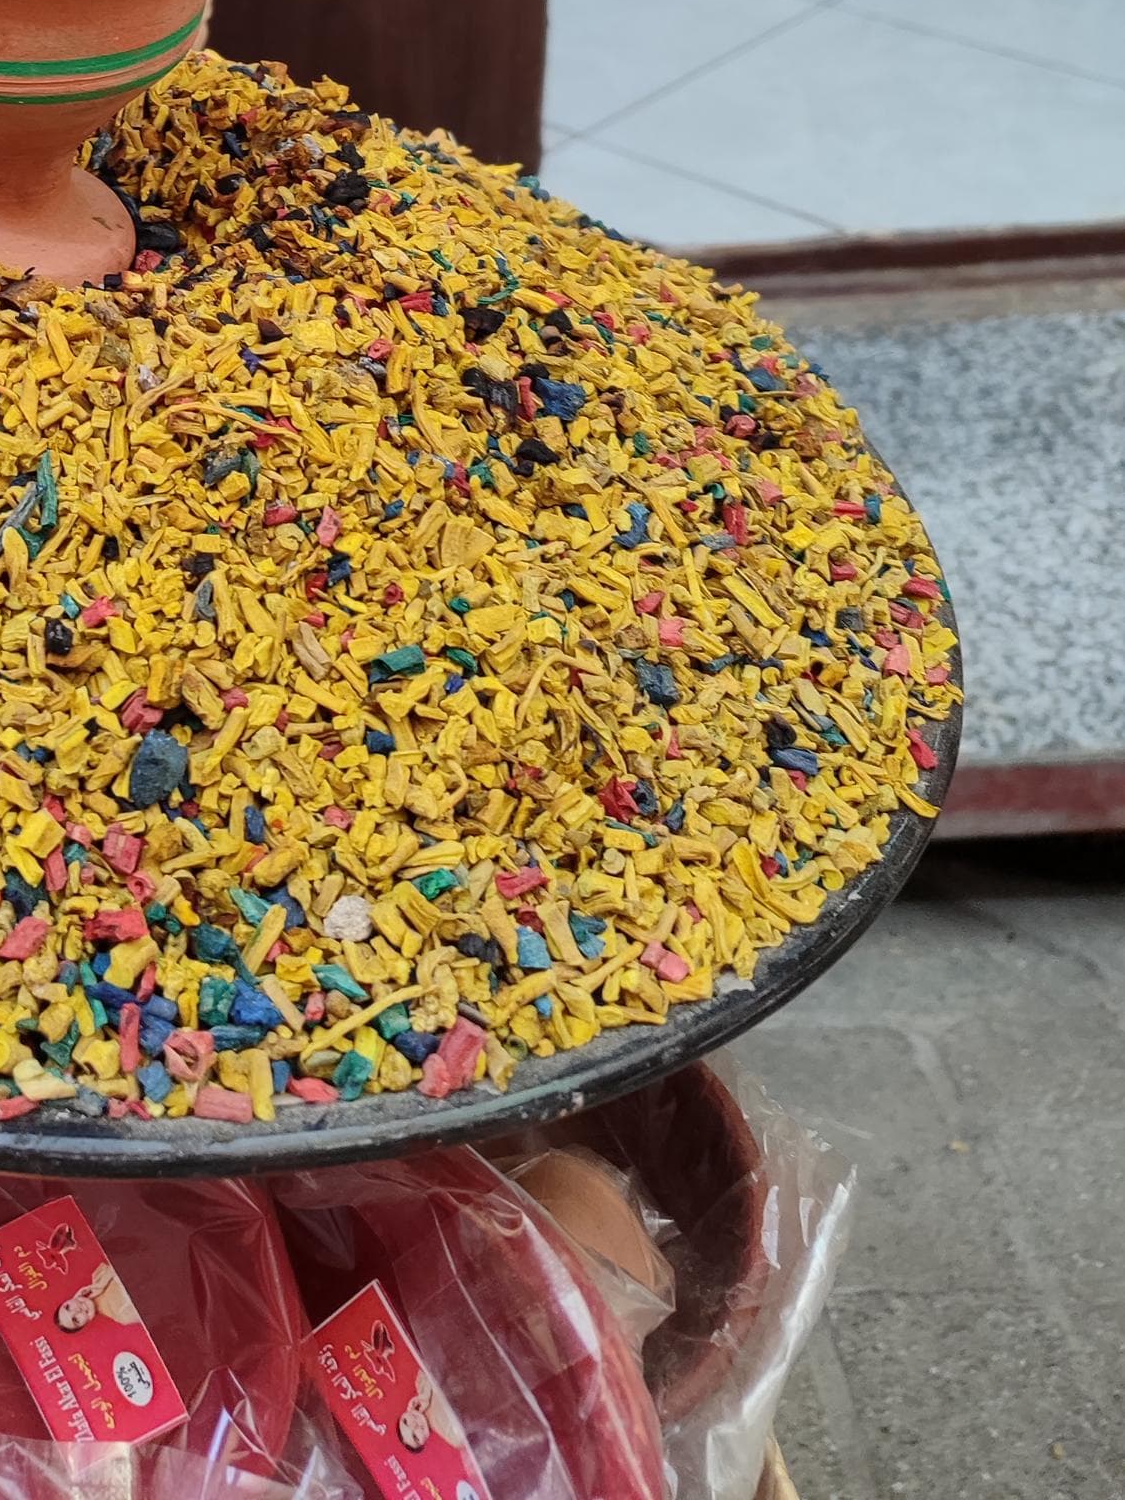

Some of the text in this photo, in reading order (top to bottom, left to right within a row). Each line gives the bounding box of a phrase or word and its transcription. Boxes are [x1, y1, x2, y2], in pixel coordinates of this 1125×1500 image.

[13, 1245, 48, 1291] دم الغزال
[5, 1295, 43, 1321] الفاسي
[29, 1336, 56, 1369] Fassi
[43, 1366, 64, 1384] El
[117, 1366, 137, 1398] 100%
[344, 1345, 384, 1400] دم الغزال
[56, 1379, 79, 1412] Akar
[67, 1353, 115, 1429] لتجميل الوجه
[350, 1403, 387, 1436] الفاسي
[383, 1455, 412, 1493] Fassi
